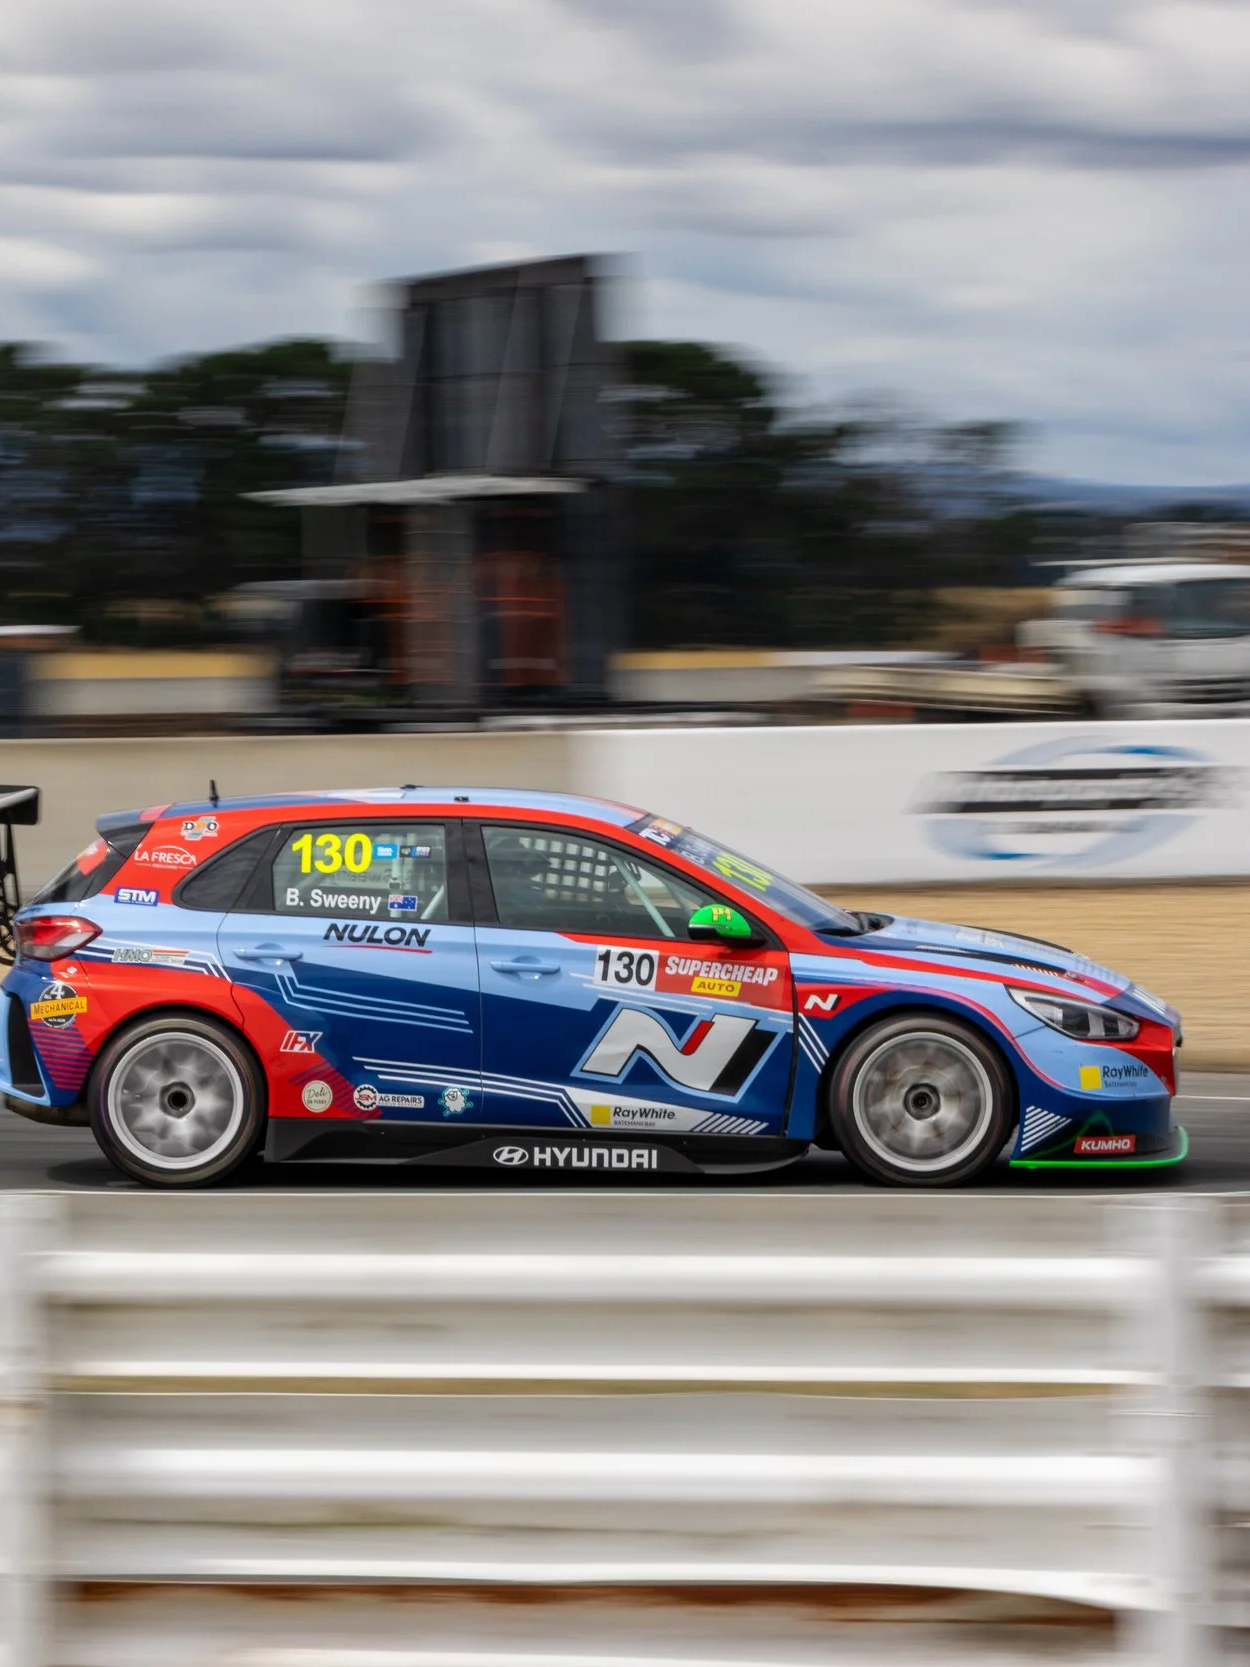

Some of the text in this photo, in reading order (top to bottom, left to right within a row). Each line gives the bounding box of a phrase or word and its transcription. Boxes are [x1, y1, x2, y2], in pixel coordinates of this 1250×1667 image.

[134, 851, 197, 865] LA FRESCA
[291, 833, 372, 874] 130
[117, 888, 157, 903] STM
[285, 888, 381, 915] B. Sweeny
[323, 923, 432, 947] NULON
[111, 948, 152, 962] HMO
[598, 949, 779, 986] 130 SUPERCHEAP
[697, 981, 736, 993] AUTO
[33, 1001, 85, 1015] MECHANICAL
[307, 1086, 328, 1099] Deli
[391, 1095, 423, 1104] REPAIRS
[1081, 1139, 1131, 1150] KUMHO
[533, 1146, 657, 1169] HYUNDAI
